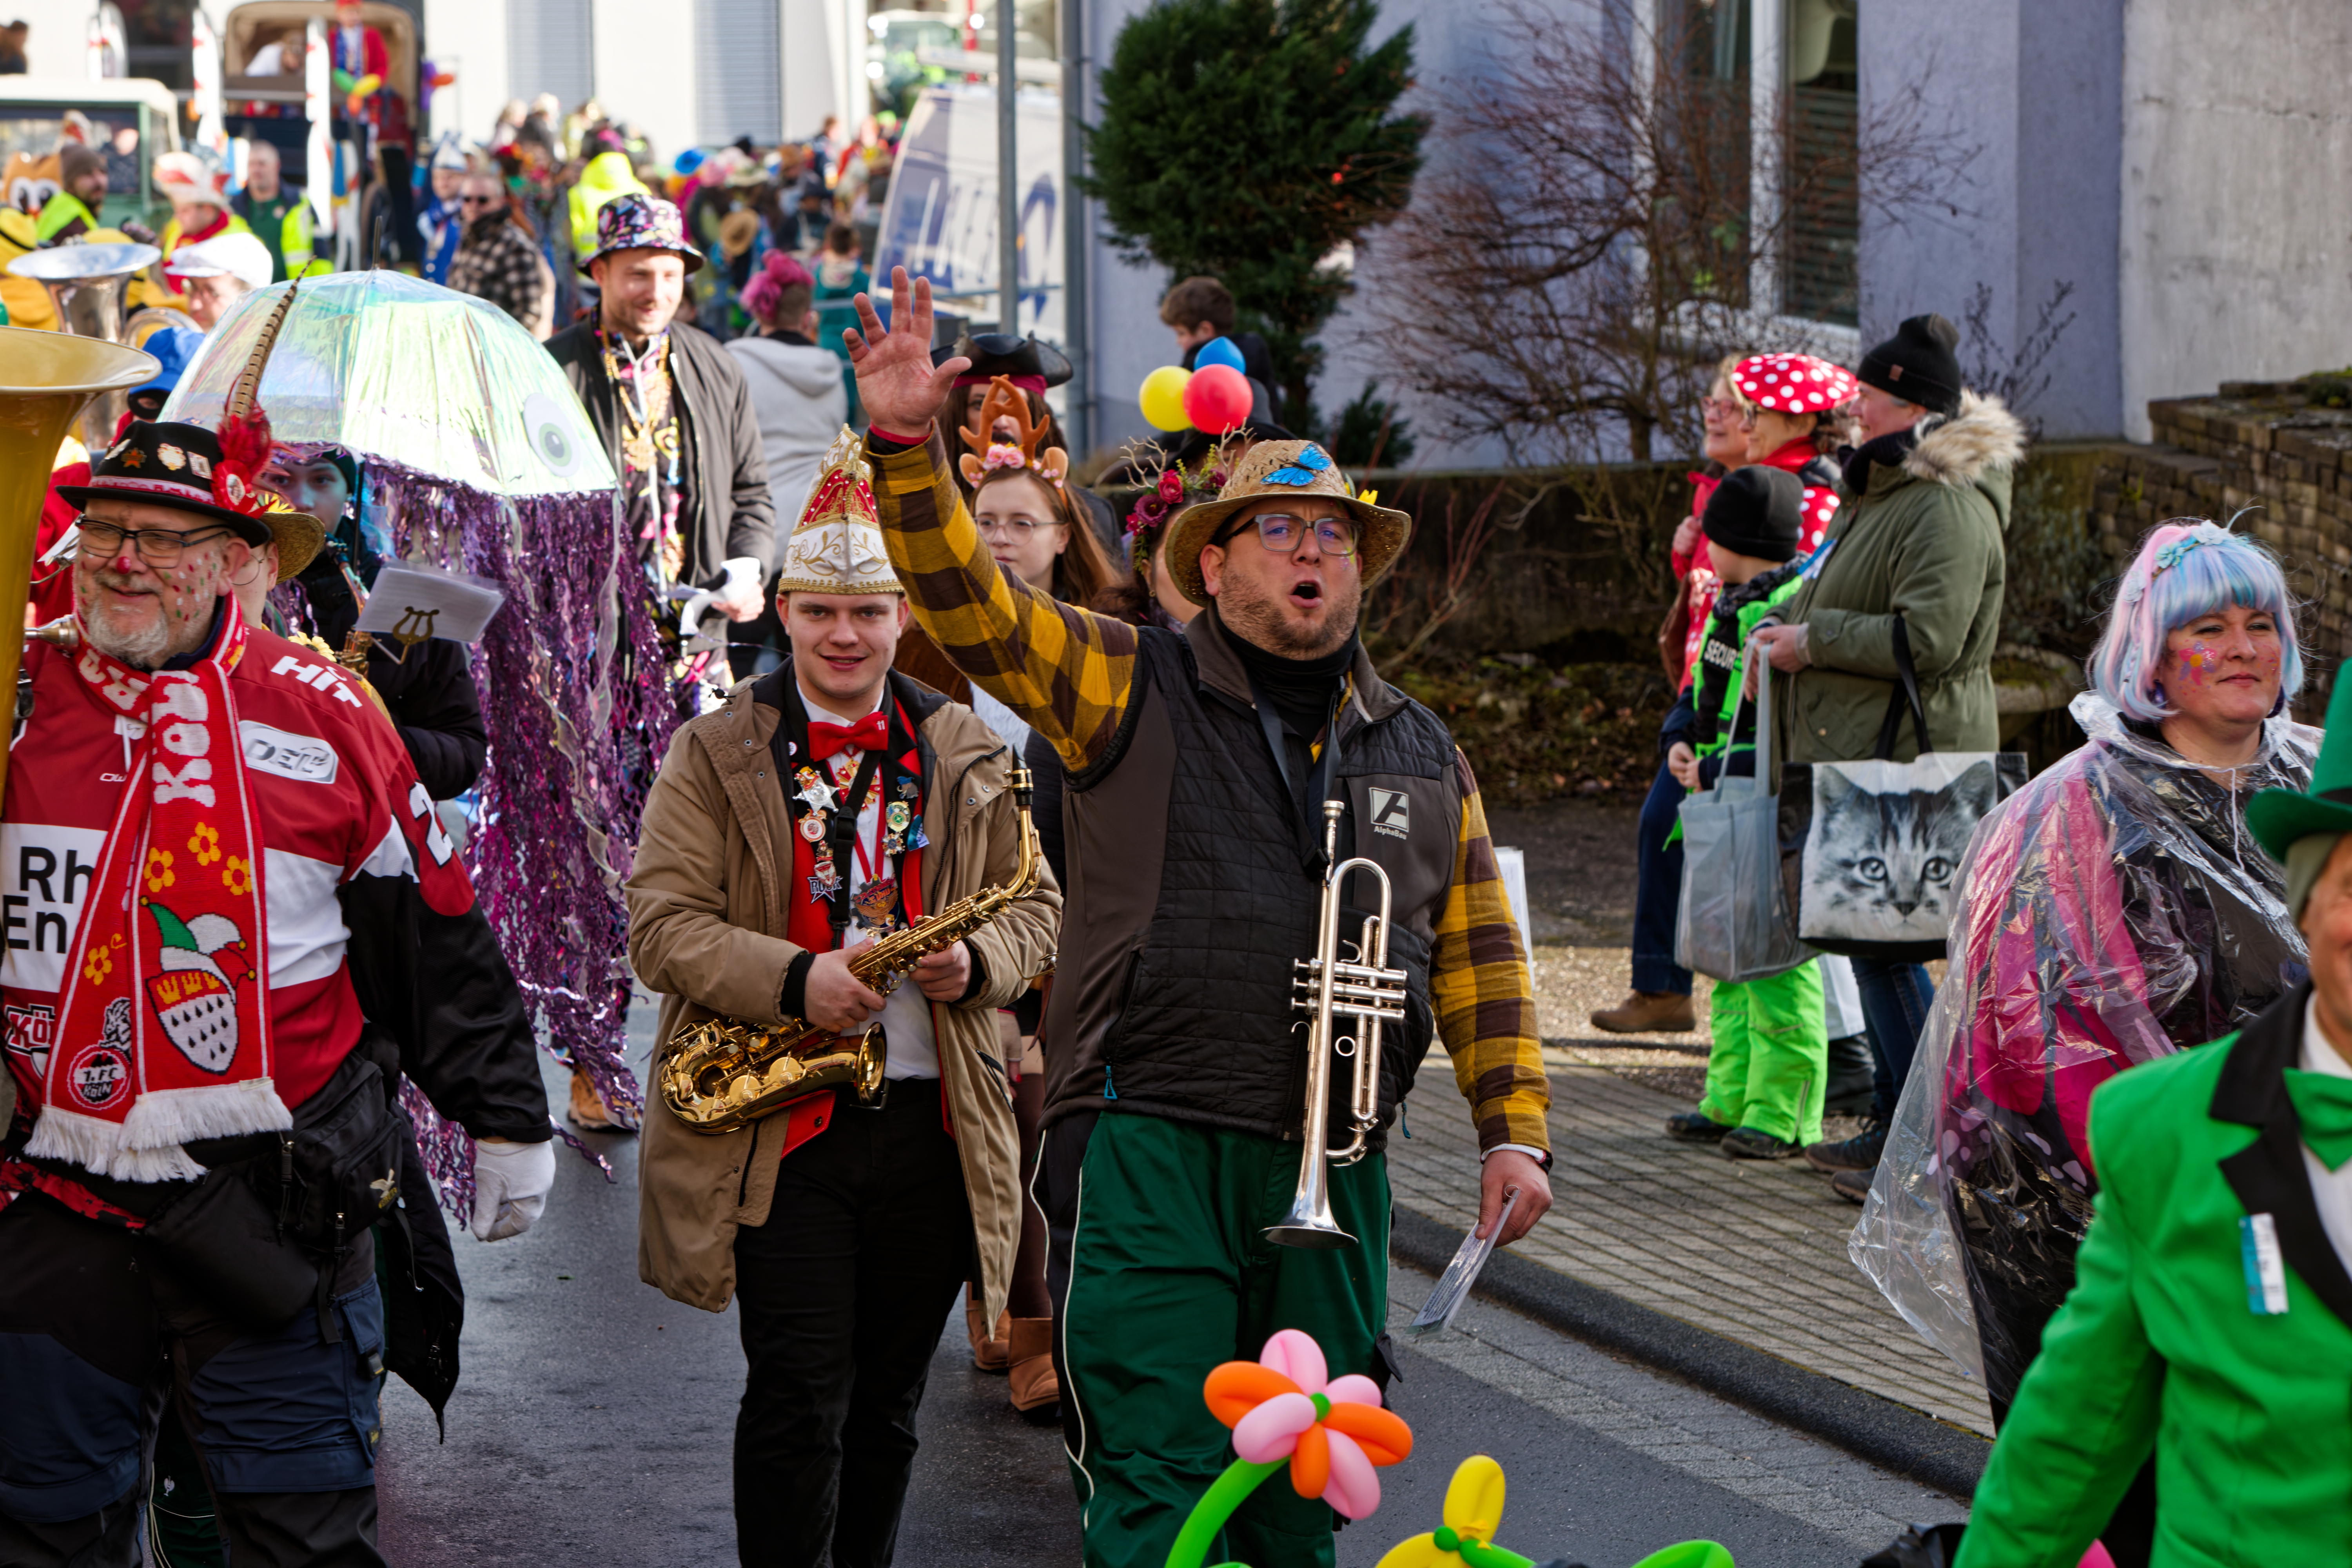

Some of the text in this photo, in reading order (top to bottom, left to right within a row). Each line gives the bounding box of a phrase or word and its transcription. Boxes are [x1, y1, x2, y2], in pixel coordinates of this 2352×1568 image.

[1704, 638, 1739, 671] SECUR
[151, 670, 216, 808] KÖL
[876, 720, 886, 731] 11
[244, 738, 316, 775] DEL
[1374, 825, 1407, 840] AlphaBau
[8, 1009, 54, 1050] KÖ
[83, 1082, 113, 1098] KÖLN
